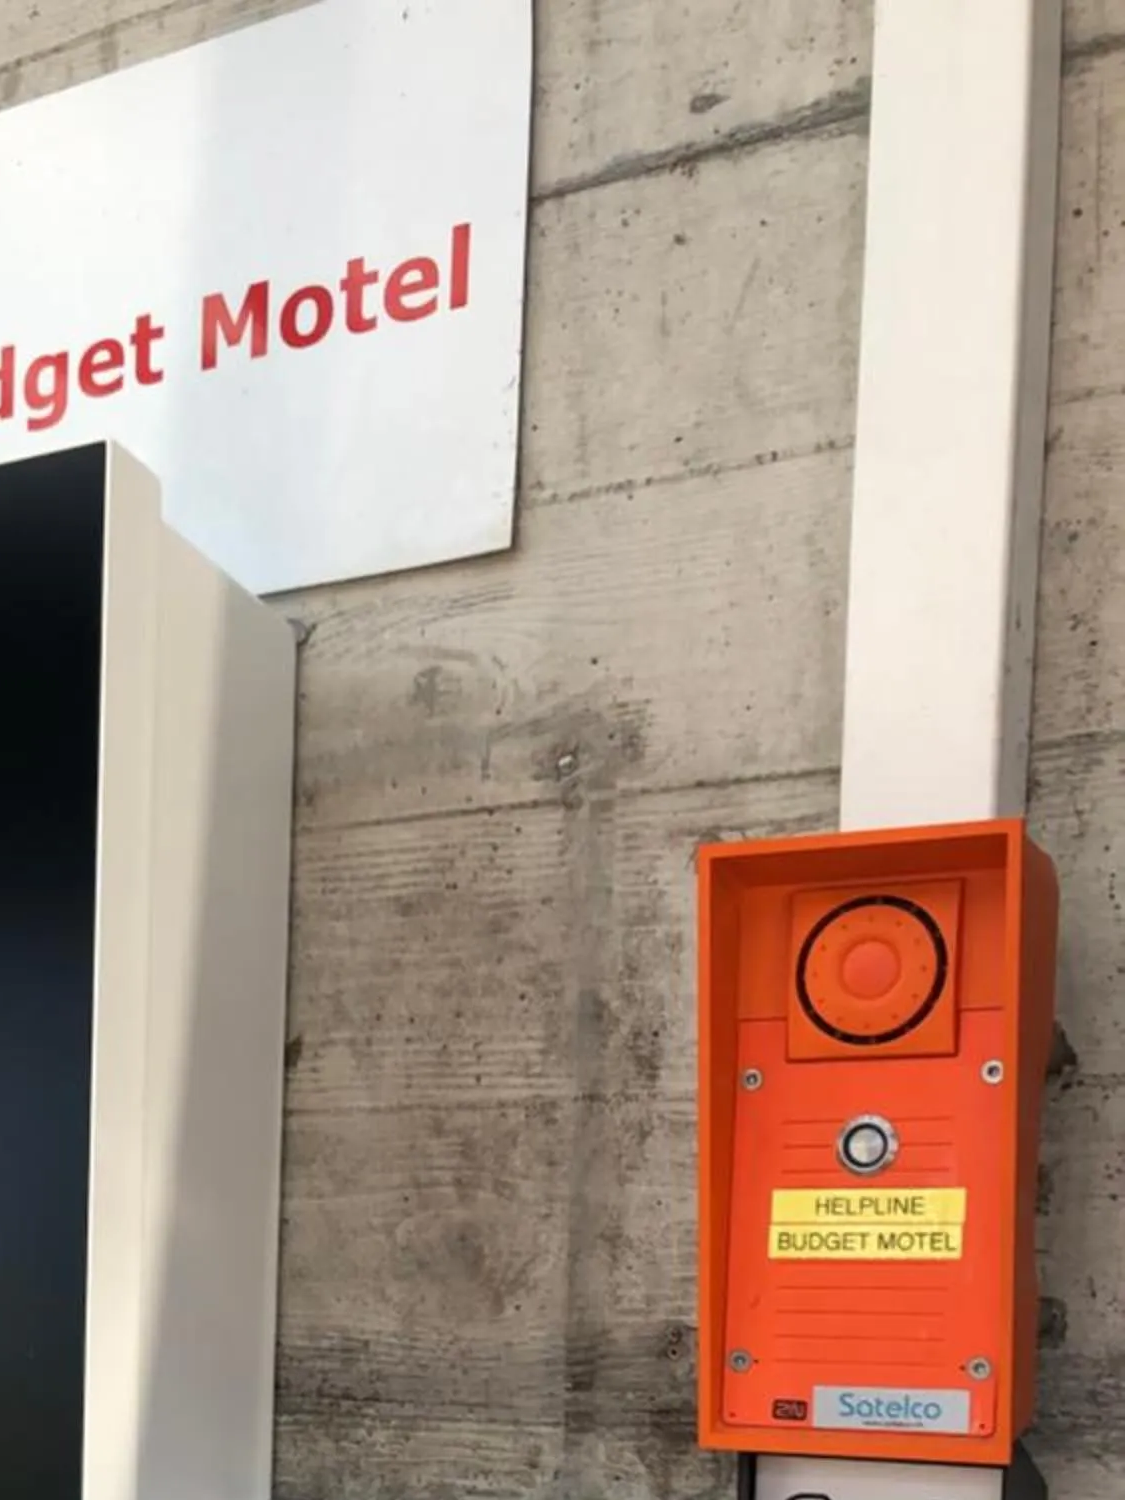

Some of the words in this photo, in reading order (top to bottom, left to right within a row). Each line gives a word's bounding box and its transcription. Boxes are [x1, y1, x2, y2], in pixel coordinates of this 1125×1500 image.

[199, 222, 471, 370] Motel
[814, 1196, 925, 1216] HELPLINE
[777, 1232, 870, 1251] BUDGET
[877, 1232, 957, 1251] MOTEL
[839, 1392, 942, 1419] Satelco
